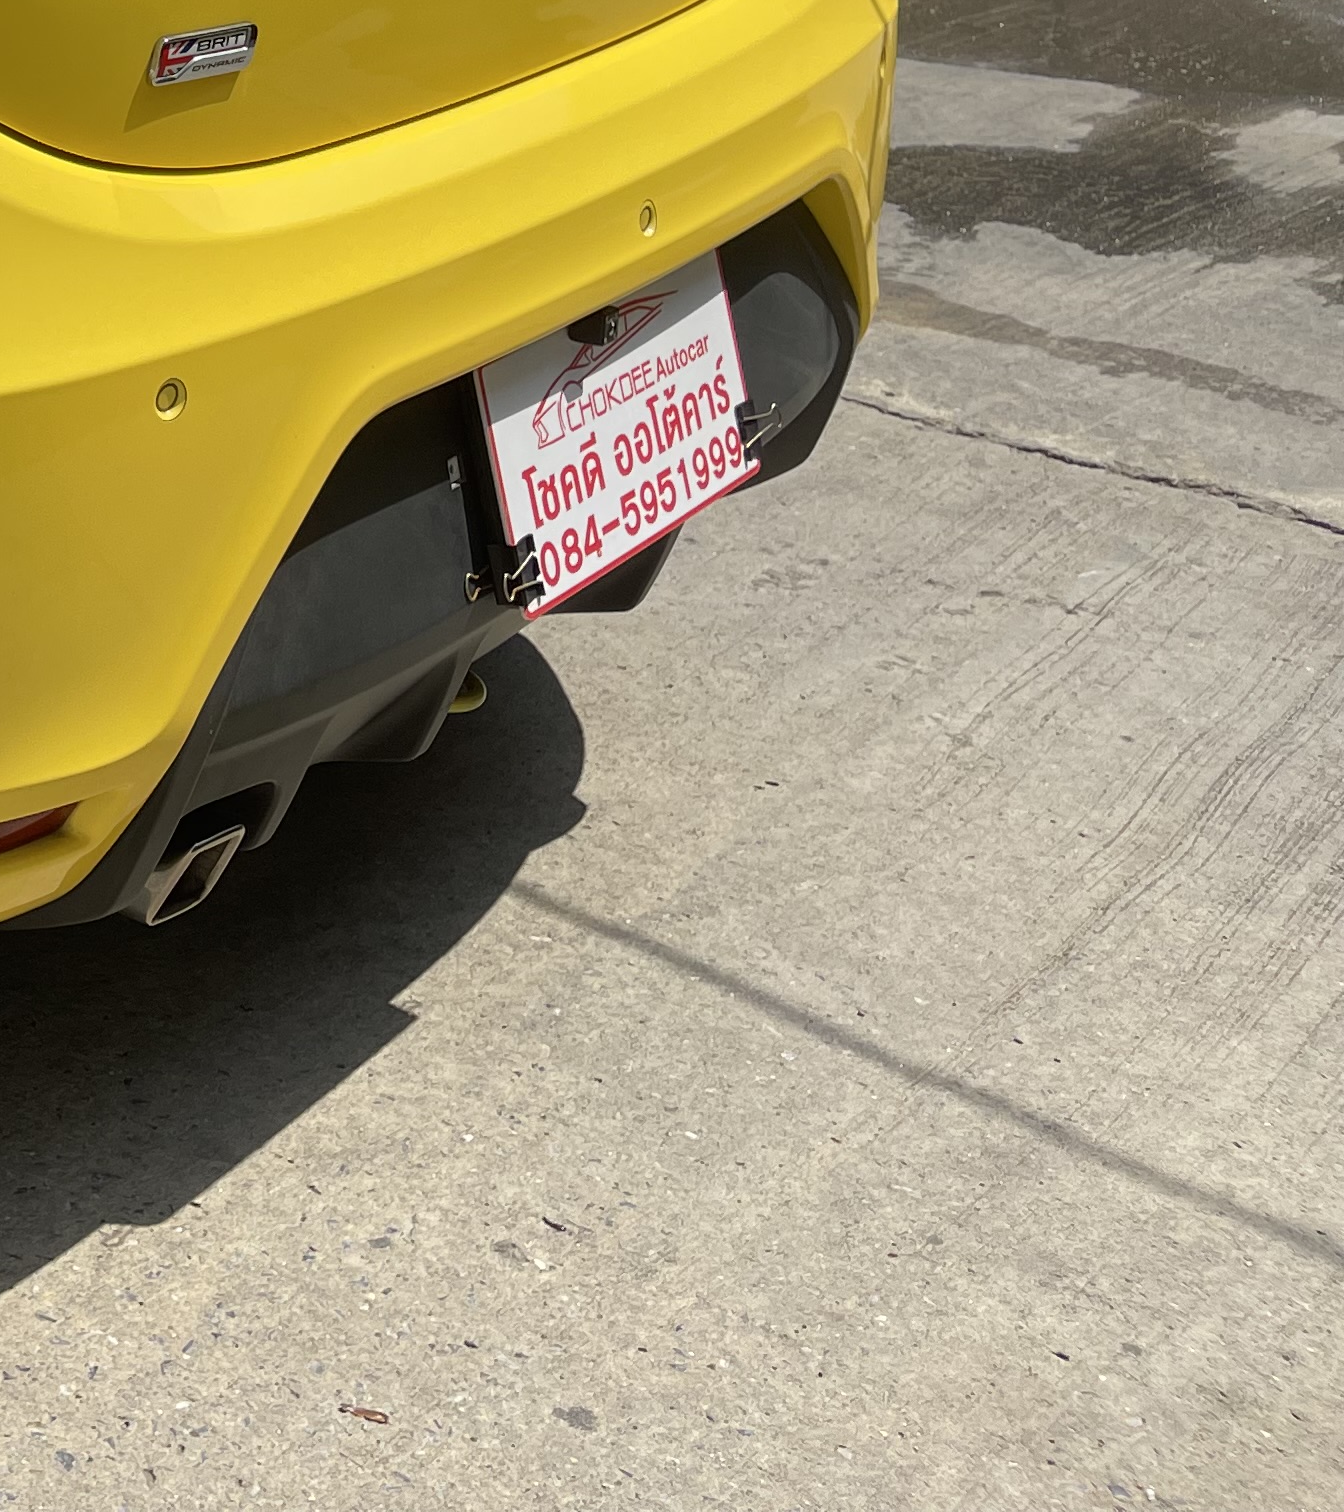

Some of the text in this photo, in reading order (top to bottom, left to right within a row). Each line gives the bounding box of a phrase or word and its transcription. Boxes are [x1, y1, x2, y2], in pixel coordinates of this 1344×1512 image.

[192, 56, 246, 71] DYNAMIC
[197, 33, 244, 51] BRIT
[565, 334, 710, 433] CHOKDEE Autocar
[613, 354, 731, 477] ออโต้คาร์
[539, 425, 743, 587] 084-5951999
